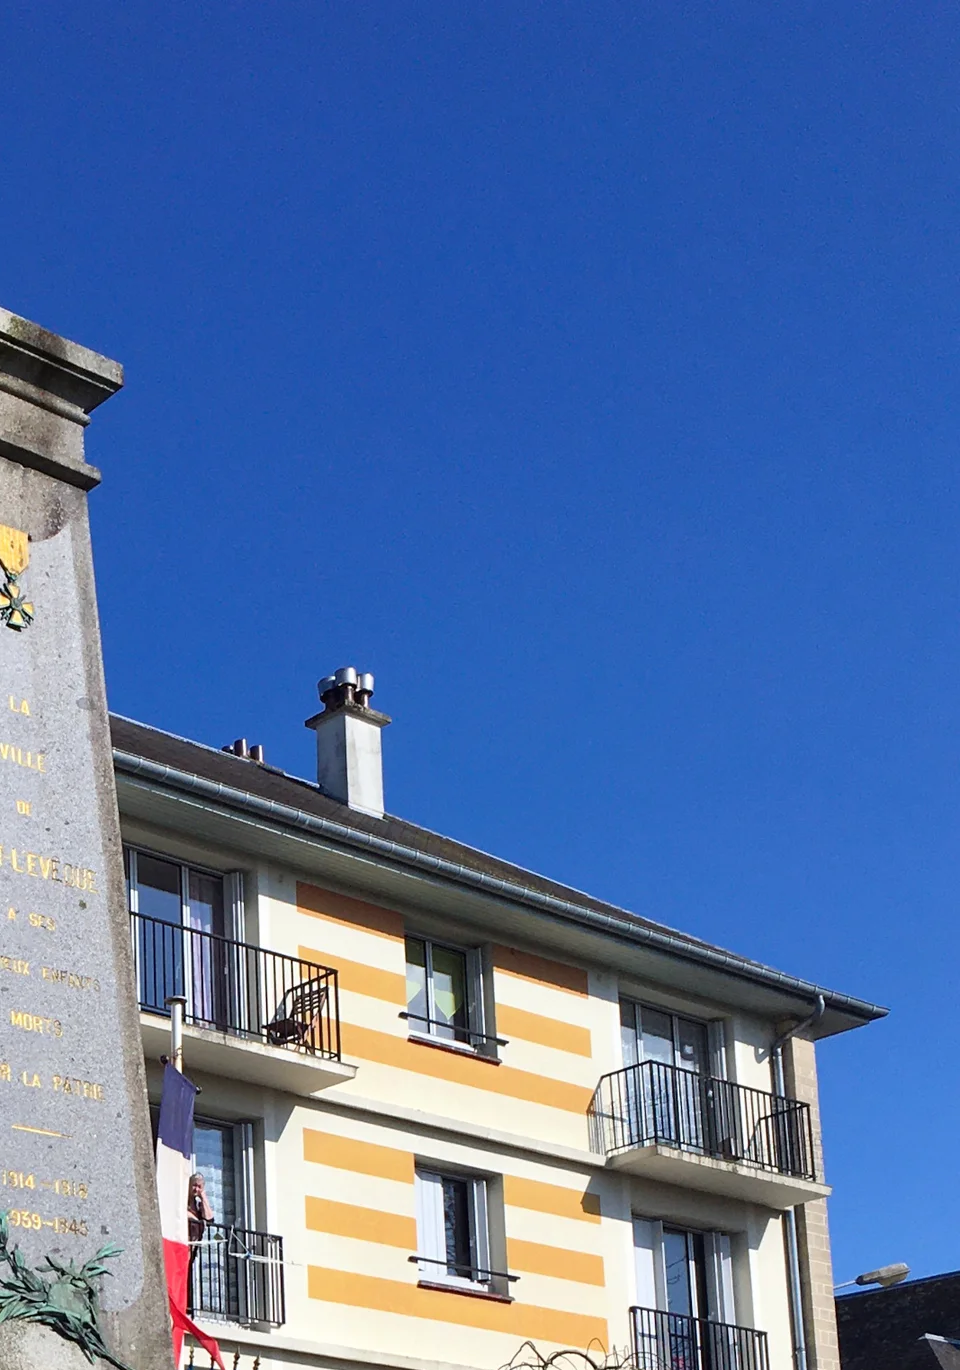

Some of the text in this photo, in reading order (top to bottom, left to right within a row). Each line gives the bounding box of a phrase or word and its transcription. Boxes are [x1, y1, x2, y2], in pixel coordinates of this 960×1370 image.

[9, 695, 31, 716] LA
[0, 743, 47, 773] VILLE
[29, 912, 56, 932] SES
[41, 966, 101, 993] ENFANTS
[10, 1010, 64, 1038] MORTS
[22, 1070, 41, 1088] LA
[52, 1074, 106, 1102] PATRIE
